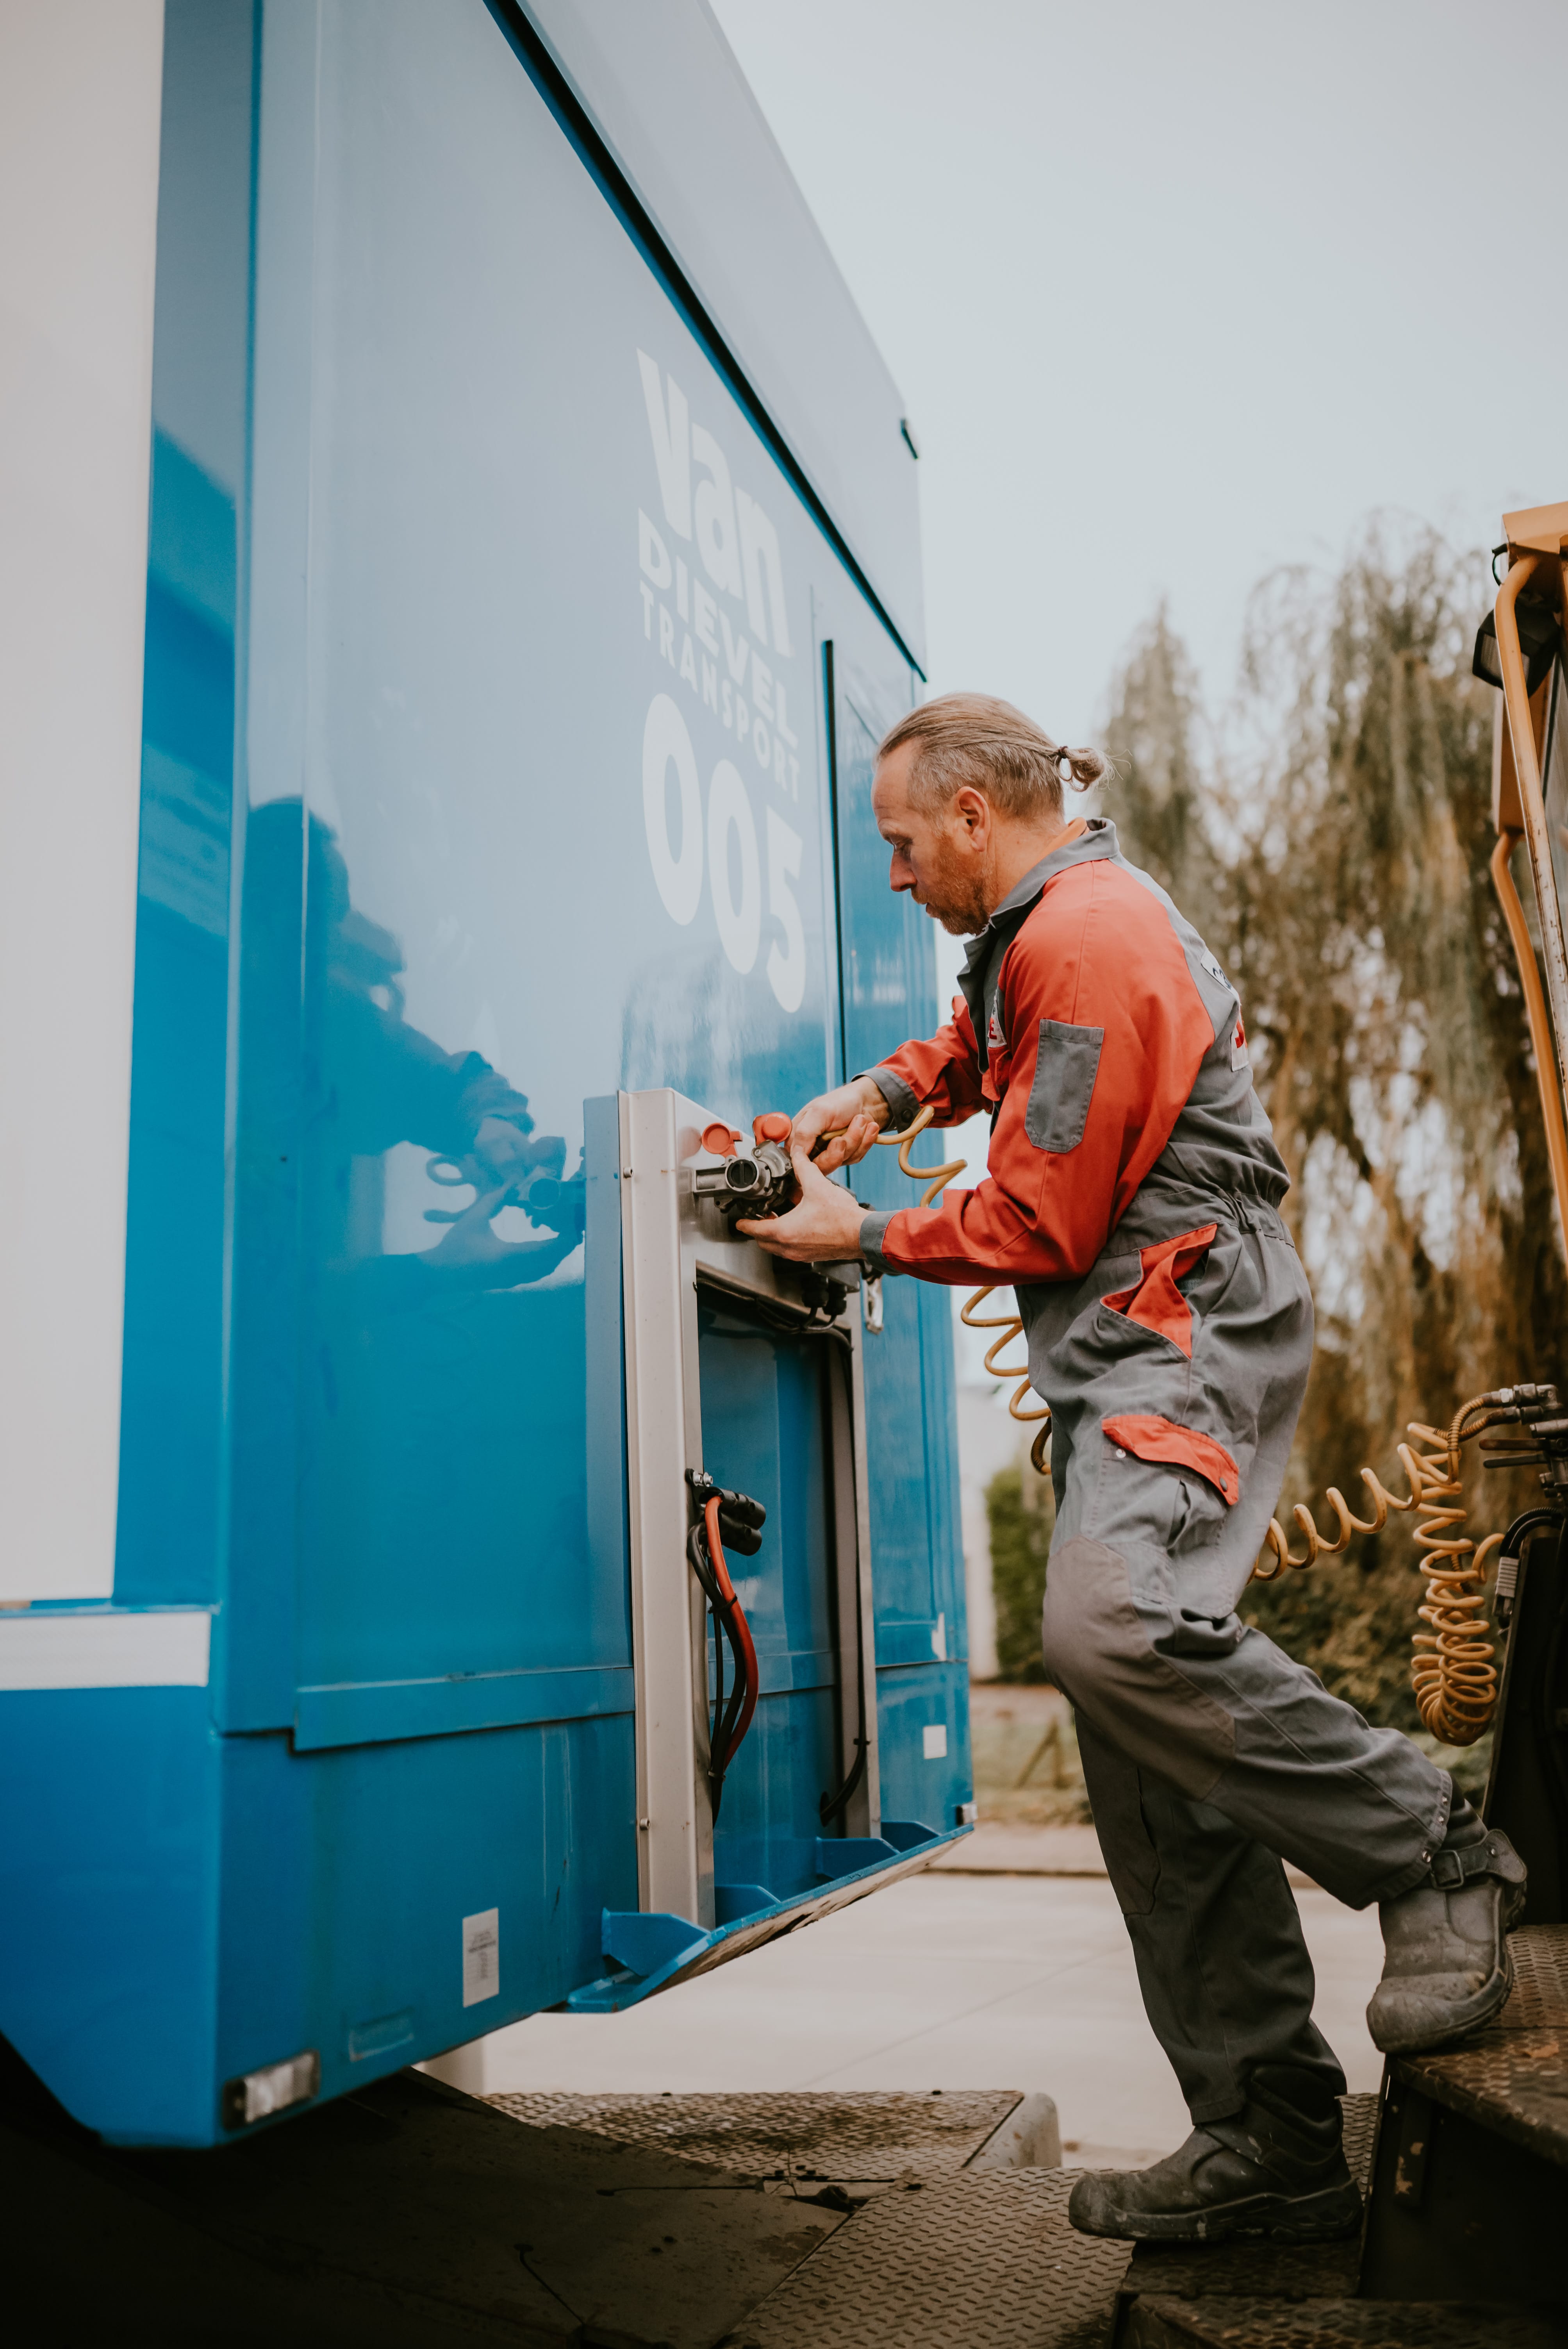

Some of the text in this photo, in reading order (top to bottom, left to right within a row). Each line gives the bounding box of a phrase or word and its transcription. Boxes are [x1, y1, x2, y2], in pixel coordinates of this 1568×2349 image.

[638, 507, 798, 749] DIEVEL
[640, 579, 799, 803] TRANSPORT
[642, 693, 806, 1013] 005
